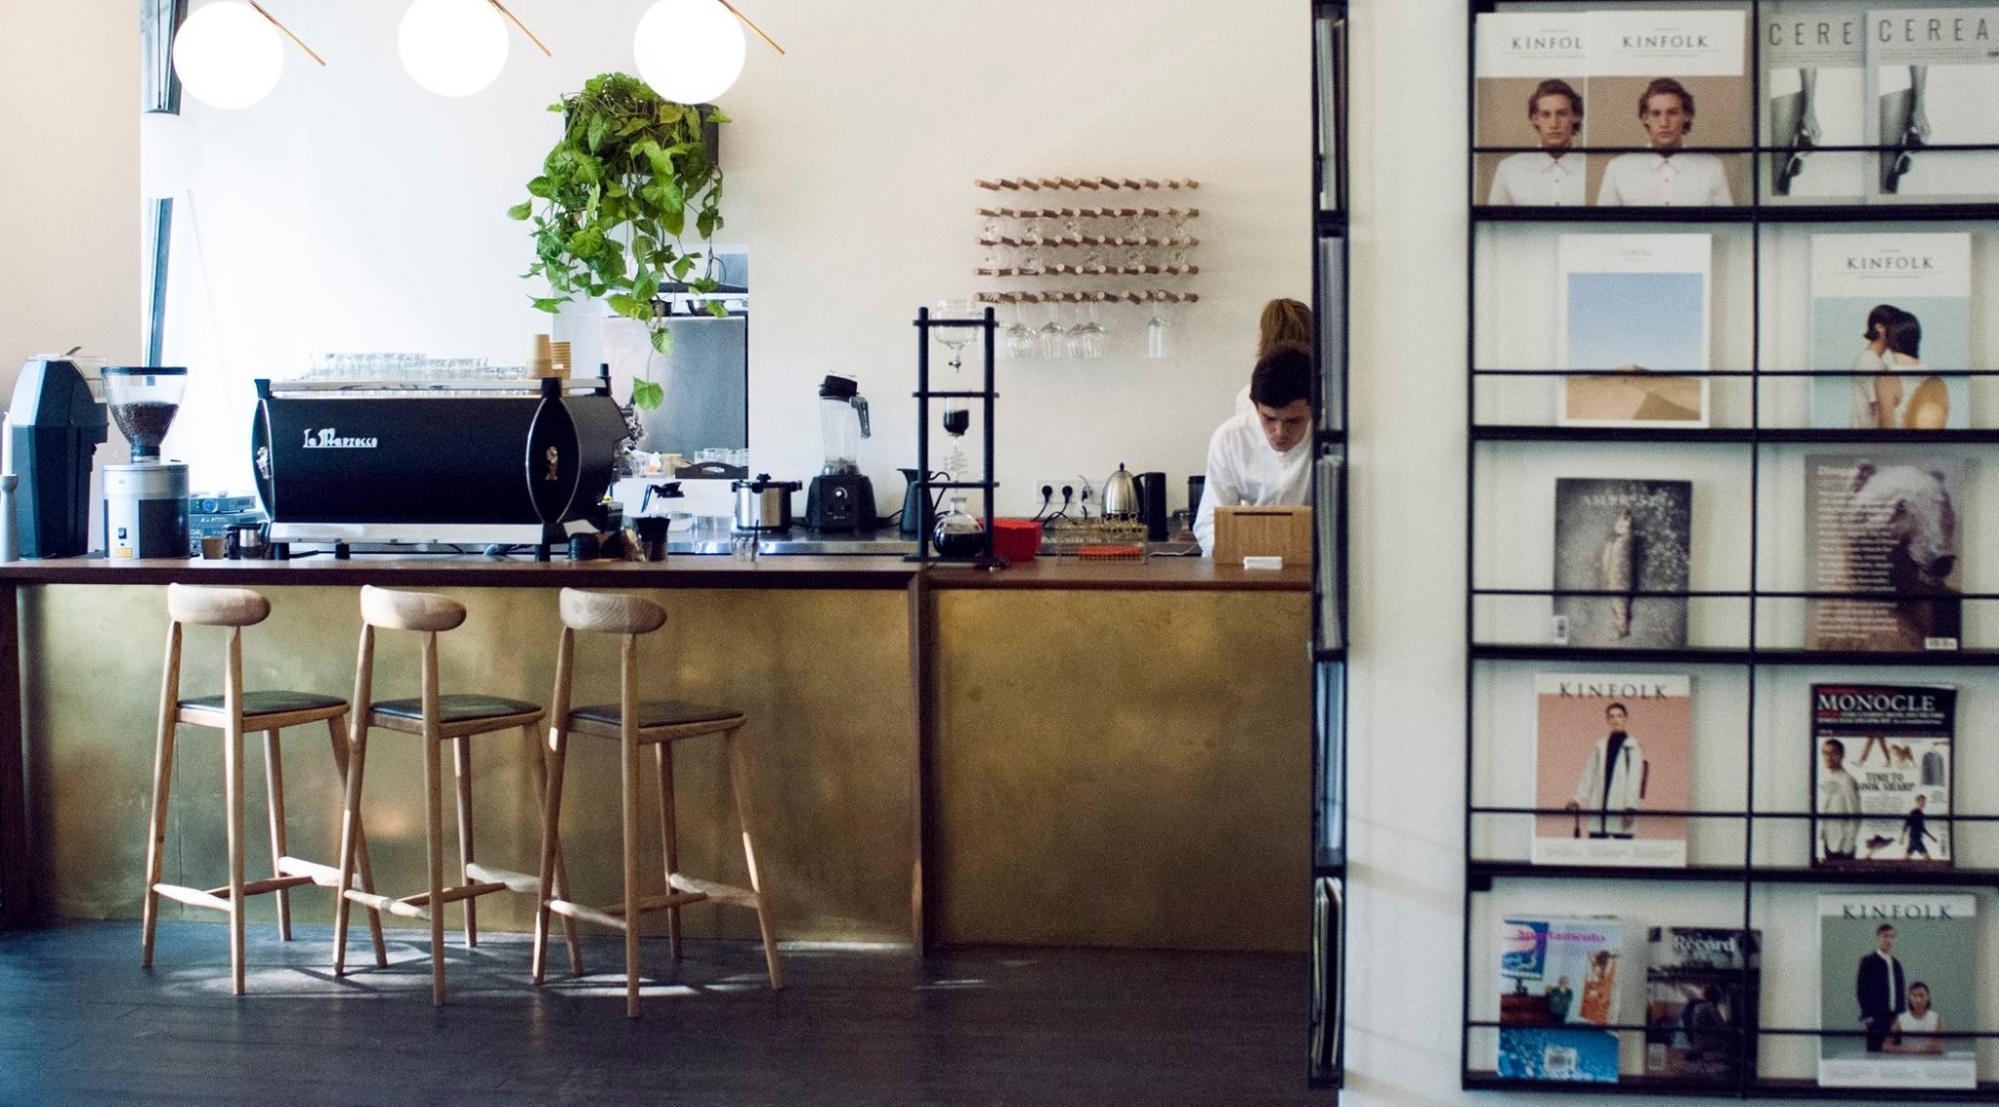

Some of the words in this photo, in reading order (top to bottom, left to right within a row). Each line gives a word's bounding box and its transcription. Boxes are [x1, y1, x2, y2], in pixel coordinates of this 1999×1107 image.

[1768, 21, 1853, 46] CERE
[1878, 17, 1990, 43] CEREA
[1511, 36, 1583, 50] KINFOL
[1621, 34, 1709, 48] KINFOLK
[1846, 256, 1935, 270] KINFOLK
[318, 427, 378, 448] Marzocco
[1560, 682, 1667, 700] KINFOLK
[1817, 693, 1936, 712] MONOCLE
[1842, 903, 1953, 920] KINFOLK
